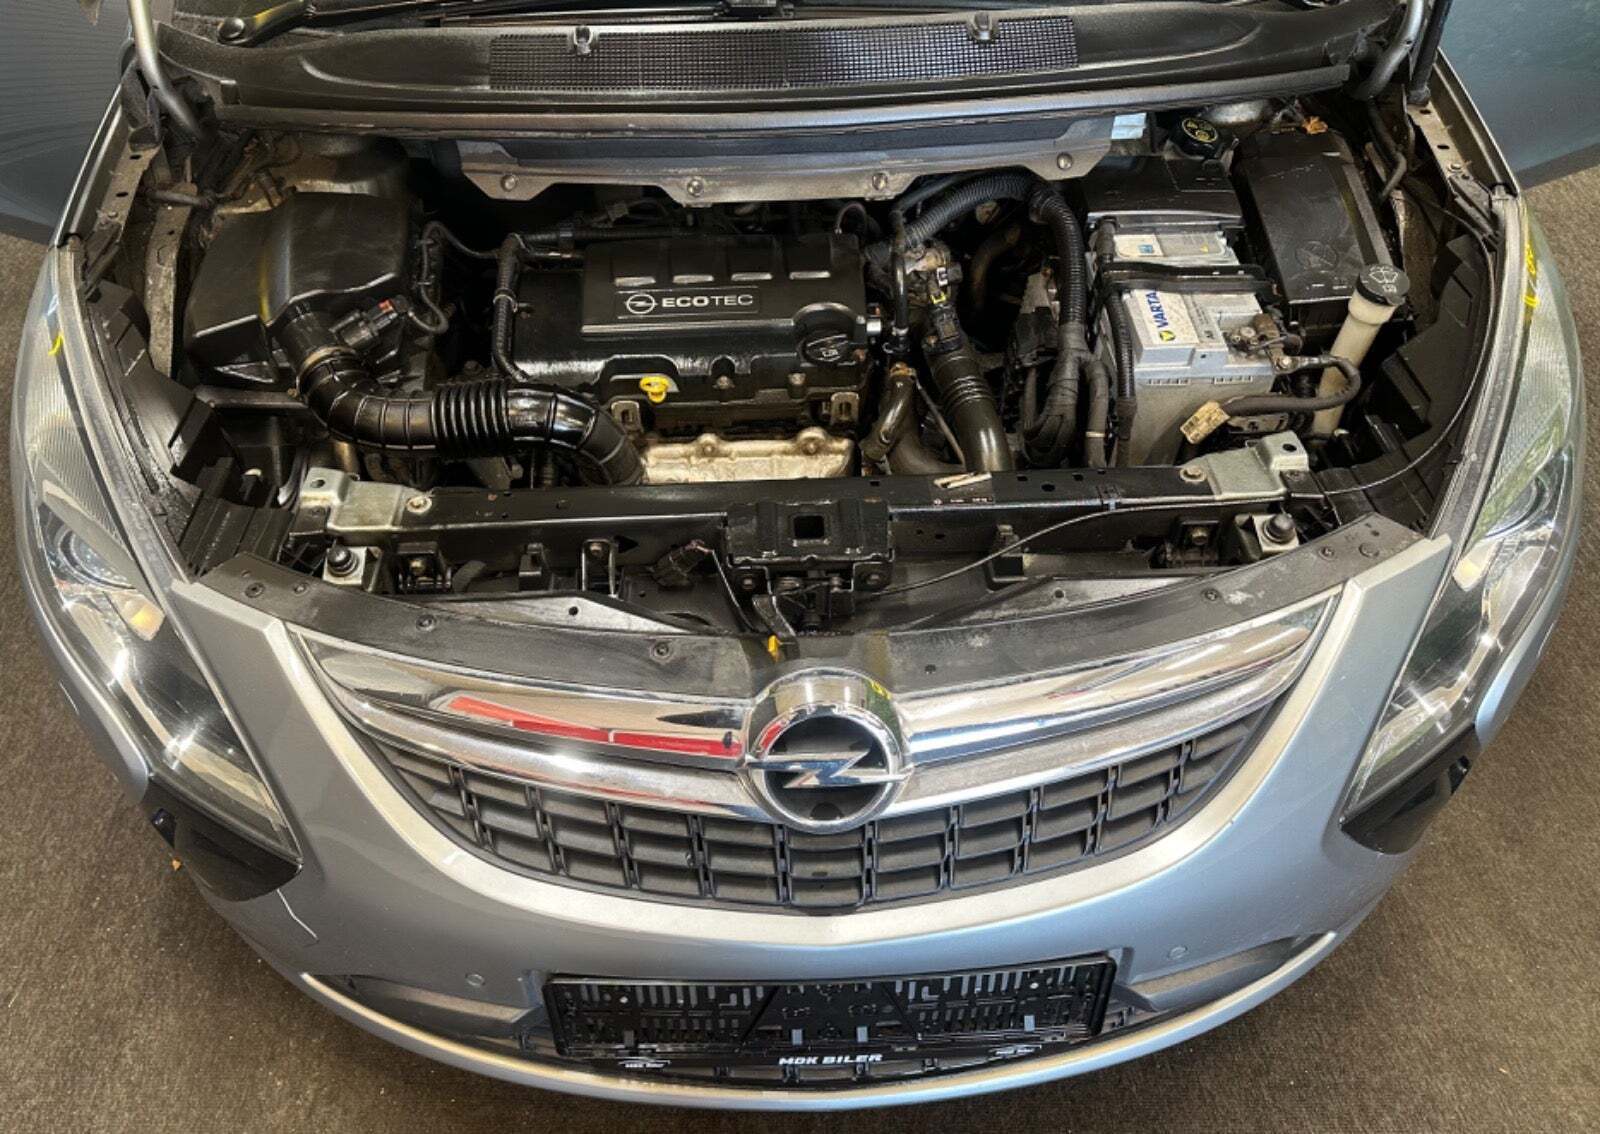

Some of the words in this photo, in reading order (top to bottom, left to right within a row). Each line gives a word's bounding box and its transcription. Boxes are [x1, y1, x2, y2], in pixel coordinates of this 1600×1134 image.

[661, 294, 753, 308] ECOTEC
[1145, 289, 1169, 328] VARTA
[822, 1053, 883, 1065] BILER
